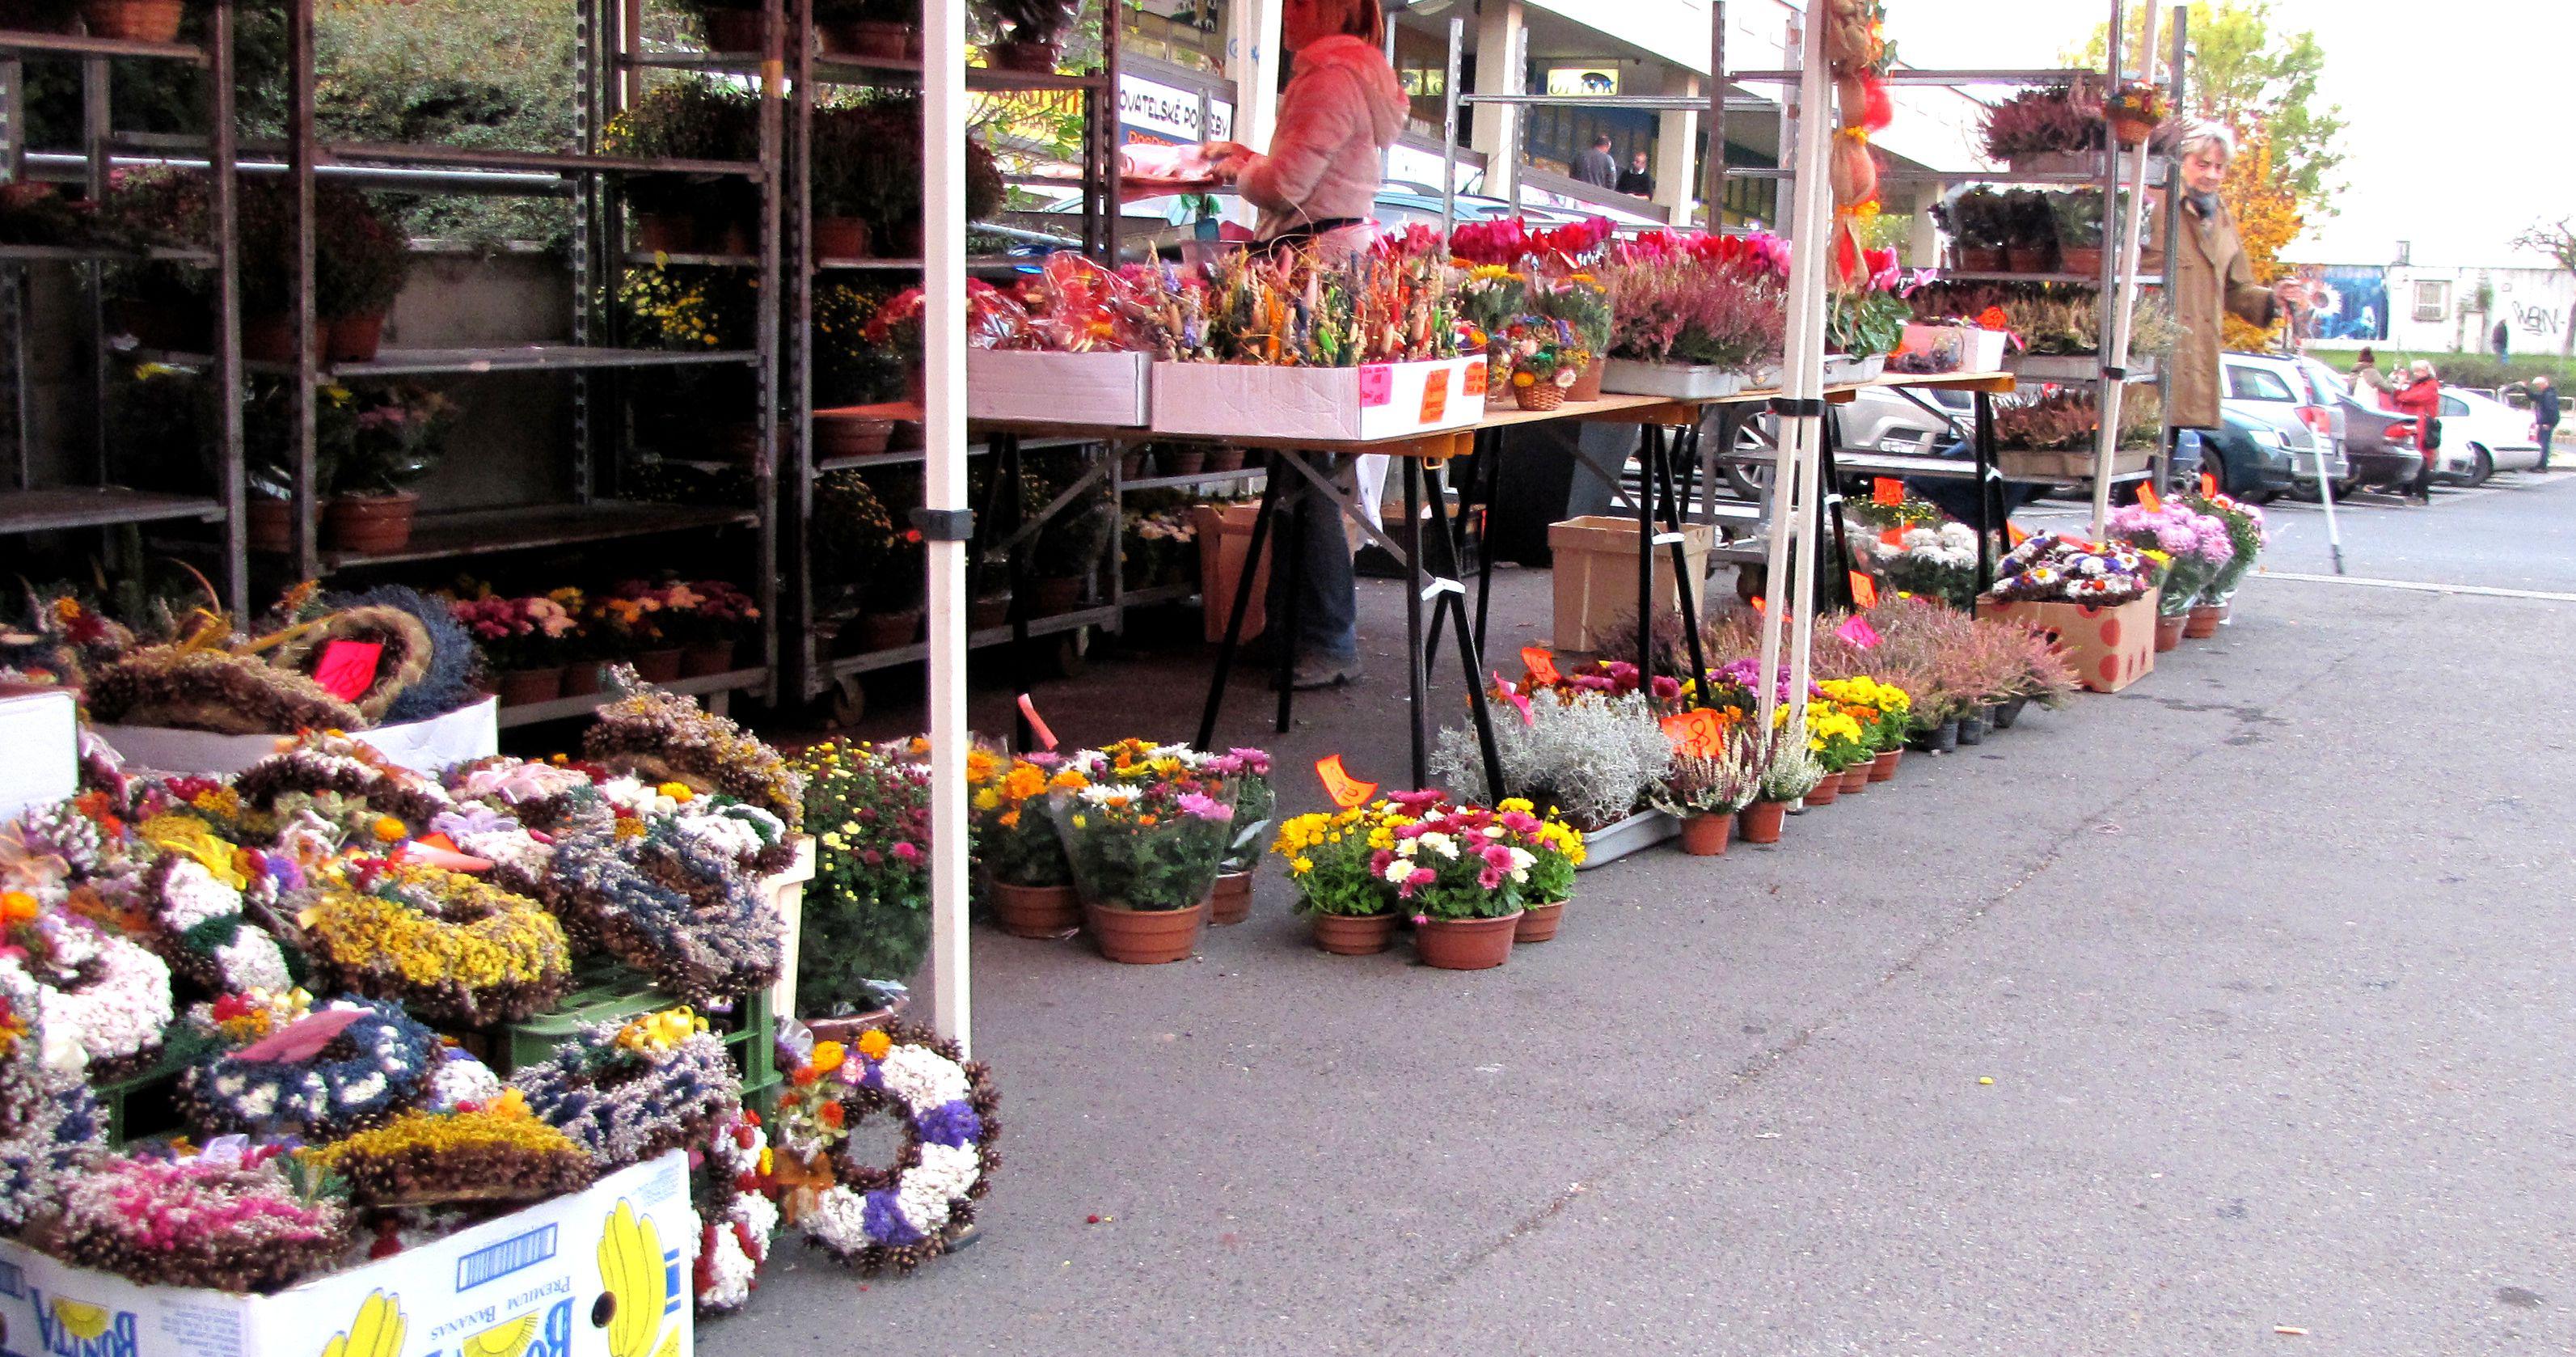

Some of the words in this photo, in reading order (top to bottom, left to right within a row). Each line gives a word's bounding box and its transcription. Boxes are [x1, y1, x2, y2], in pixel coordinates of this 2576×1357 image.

[1119, 89, 1180, 125] OVATELSKÉ
[1184, 106, 1229, 136] POEBY
[507, 1275, 571, 1310] PREMIUM
[431, 1304, 496, 1342] BANANAS
